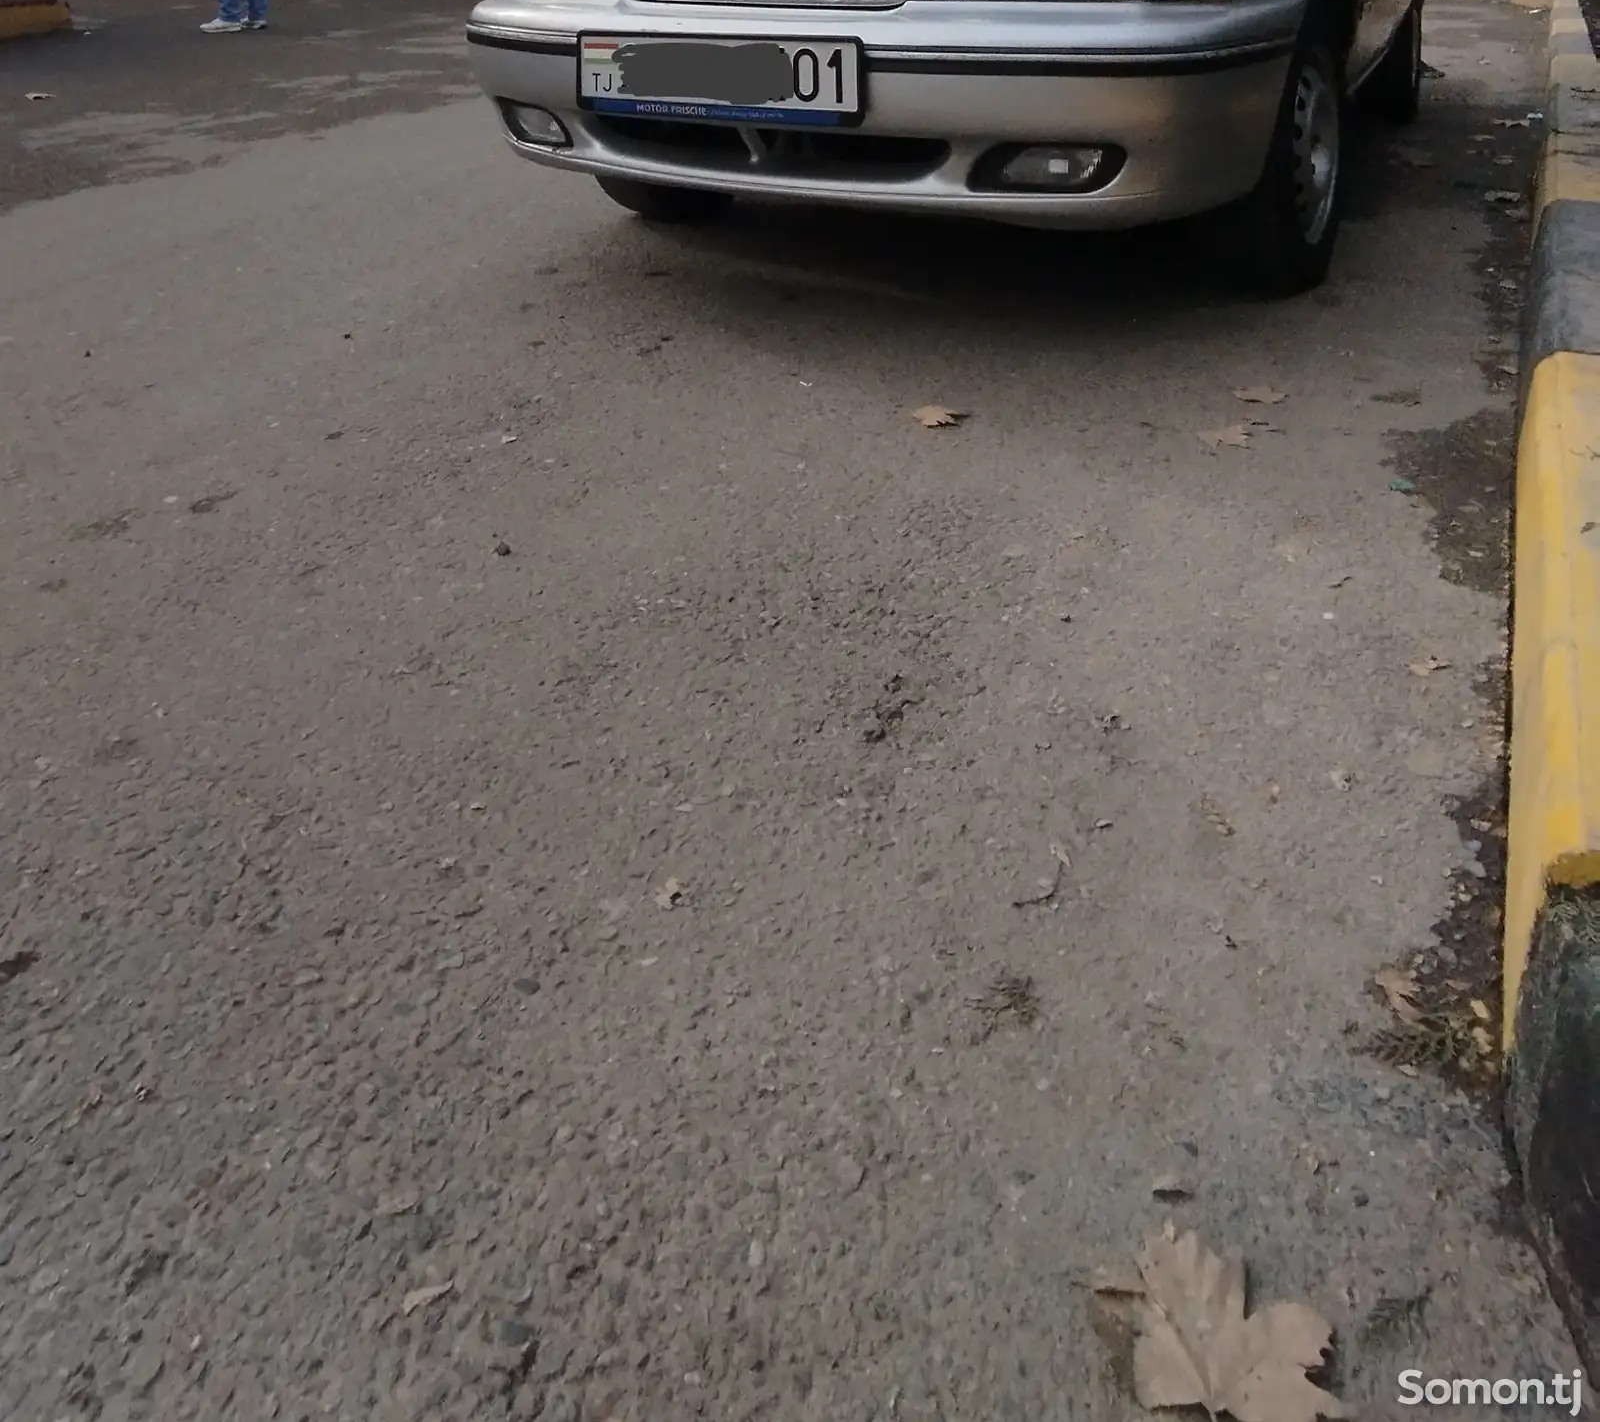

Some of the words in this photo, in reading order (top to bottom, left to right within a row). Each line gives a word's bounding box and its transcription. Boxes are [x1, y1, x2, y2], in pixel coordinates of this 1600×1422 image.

[592, 72, 612, 92] TJ
[793, 47, 843, 104] 01
[636, 103, 668, 114] MOTOR
